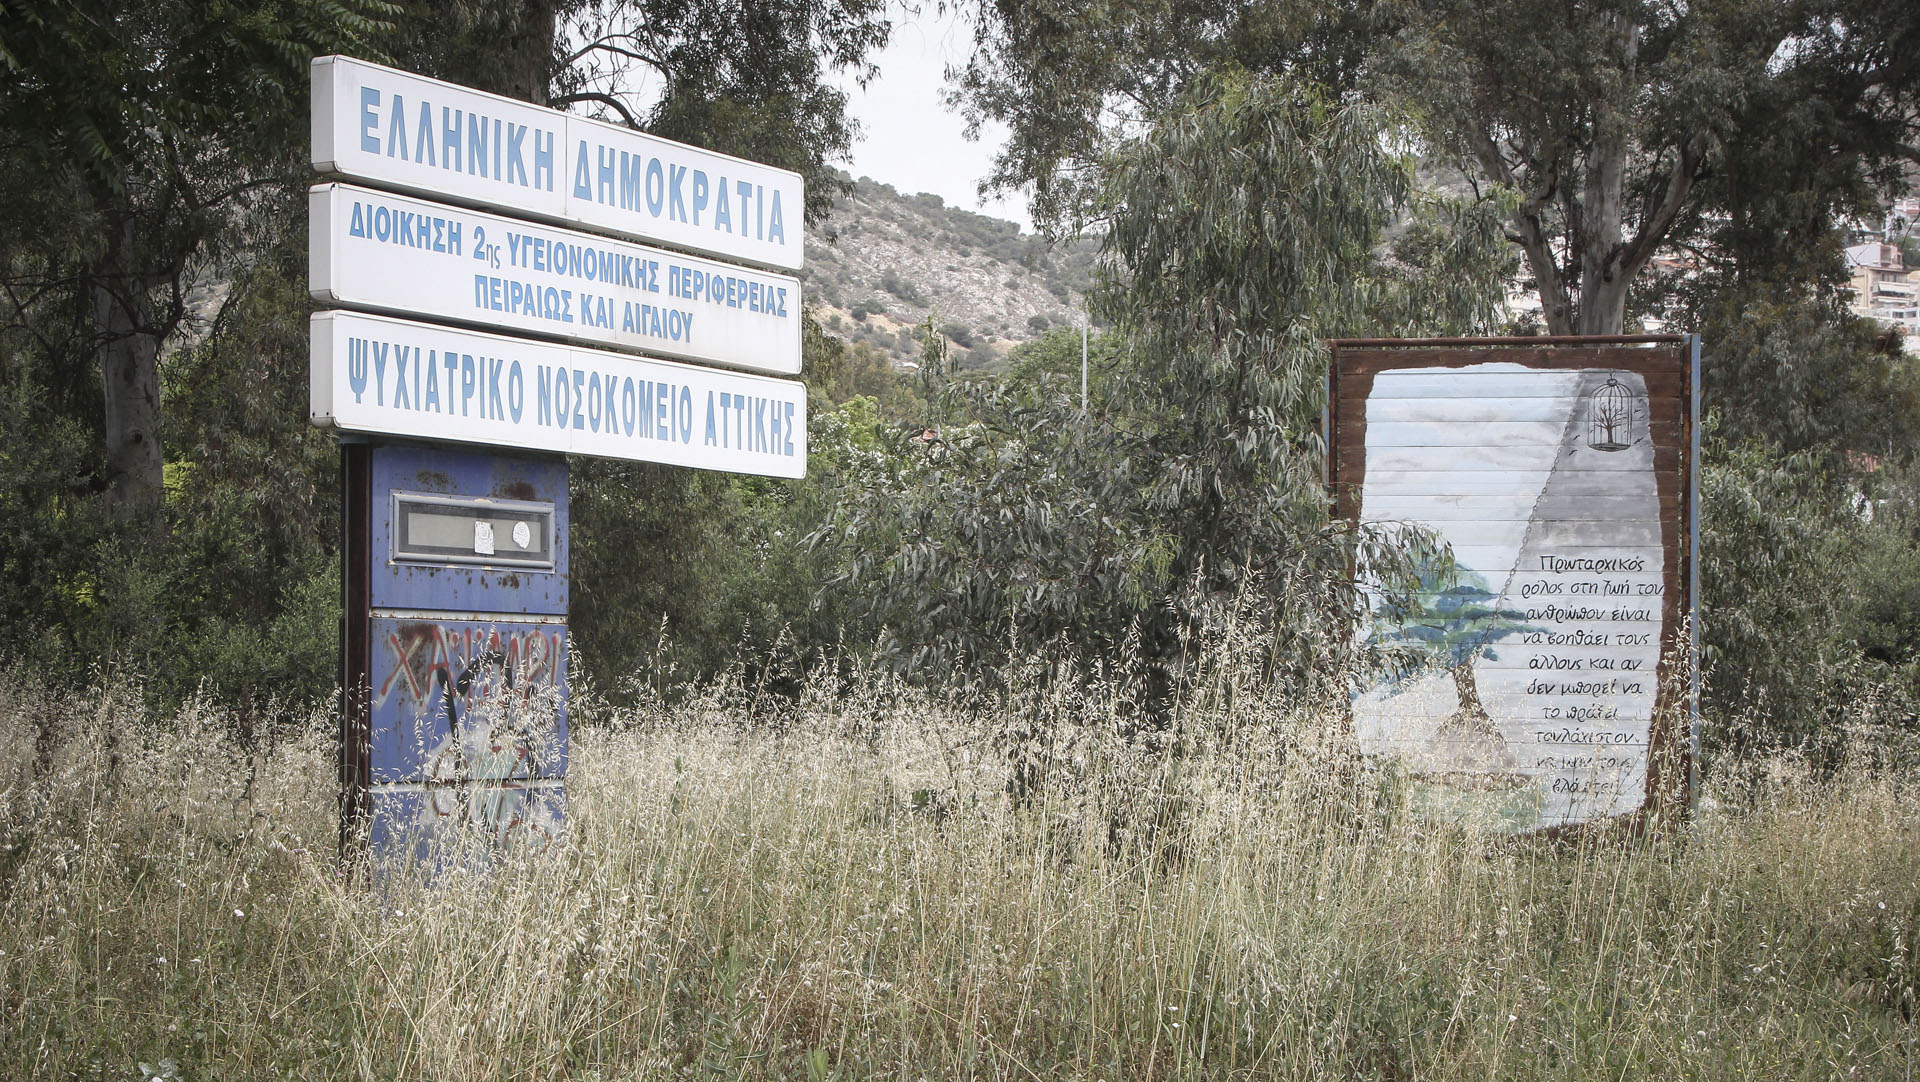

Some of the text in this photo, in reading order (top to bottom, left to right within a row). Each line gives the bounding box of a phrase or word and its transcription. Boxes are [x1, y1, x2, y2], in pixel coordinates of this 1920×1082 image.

[360, 86, 785, 246] ΕΛΛΗΝΙΚΗ ΔΗΜΟΚΡΑΤΙΑ
[350, 202, 787, 318] ΔΙΟΙΚΗΣΗ 2ης ΥΓΕΙΟΝΟΜΙΚΗΣ ΠΕΡΙΦΕΡΕΙΑΣ
[475, 274, 693, 343] ΠΕΙΡΑΙΩΣ ΚΑΙ ΑΙΓΑΙΟΥ
[348, 337, 795, 457] ΨΥΧΙΑΤΡΙΚΟ ΝΟΣΟΚΟΜΕΙΟ ΑΤΤΙΚΗΣ
[1540, 556, 1645, 574] Πρωταρχικός
[1521, 580, 1665, 599] ρόλος στη ζωή του
[1526, 604, 1650, 623] ανθρώπου είναι
[1523, 630, 1650, 645] να βοηθάει τους
[1529, 654, 1642, 671] άλλους και αν
[1527, 678, 1643, 698] δεν μπορεί να
[1542, 707, 1560, 719] το
